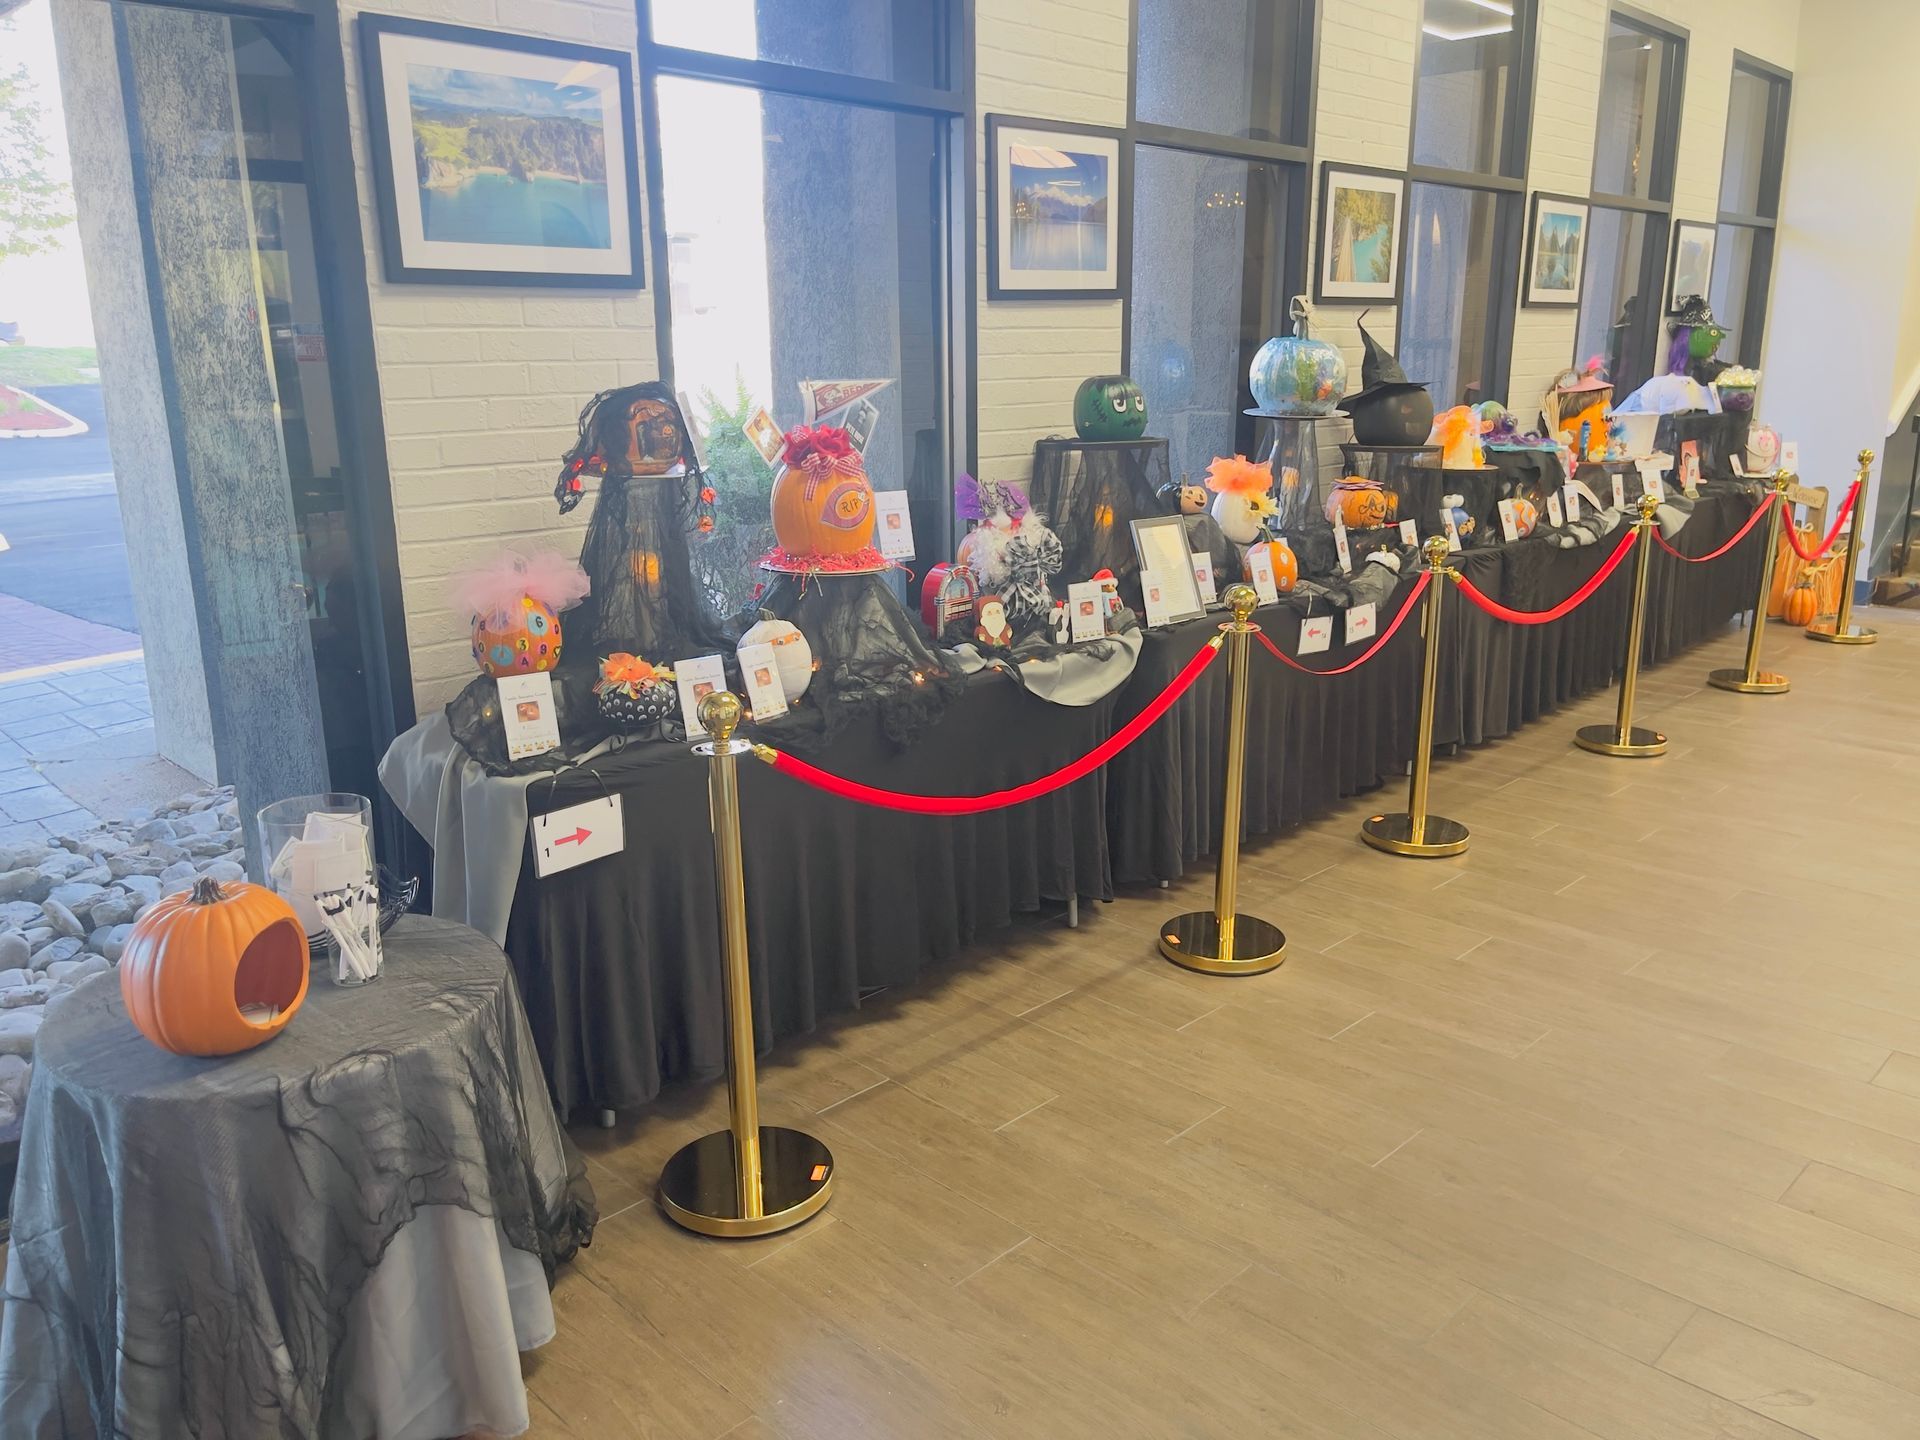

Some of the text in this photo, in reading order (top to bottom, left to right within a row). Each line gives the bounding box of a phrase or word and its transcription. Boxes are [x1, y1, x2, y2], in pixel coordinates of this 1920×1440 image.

[535, 616, 543, 628] 6
[519, 639, 527, 650] 3
[540, 644, 547, 655] 9
[544, 847, 550, 858] 1
